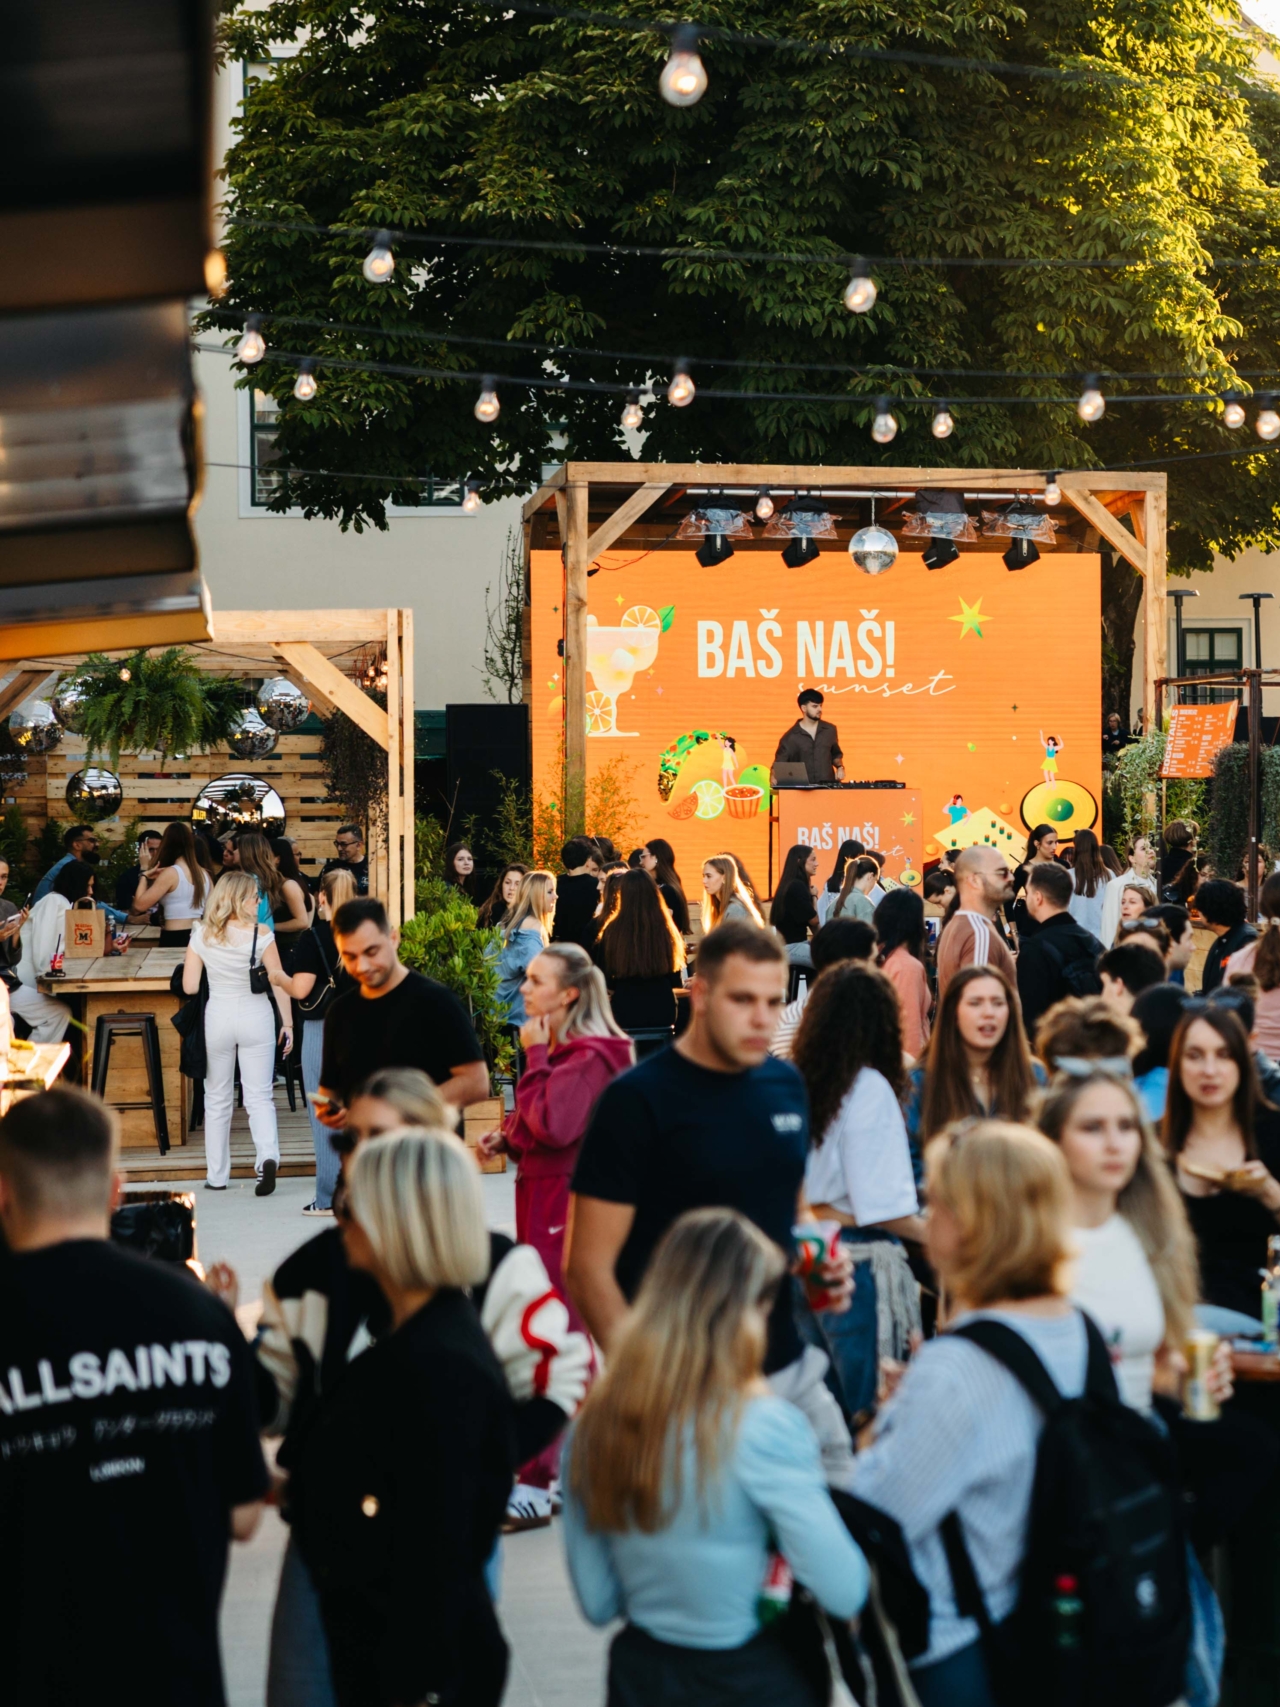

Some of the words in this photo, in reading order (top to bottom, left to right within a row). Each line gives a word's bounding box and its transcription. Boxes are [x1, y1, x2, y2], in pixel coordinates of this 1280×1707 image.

[697, 608, 783, 678] BAŠ
[796, 608, 895, 678] NAŠ!
[1162, 709, 1179, 774] COCKTAILS
[797, 822, 833, 850] BAŠ
[837, 821, 880, 849] NAŠ!
[79, 932, 88, 941] M
